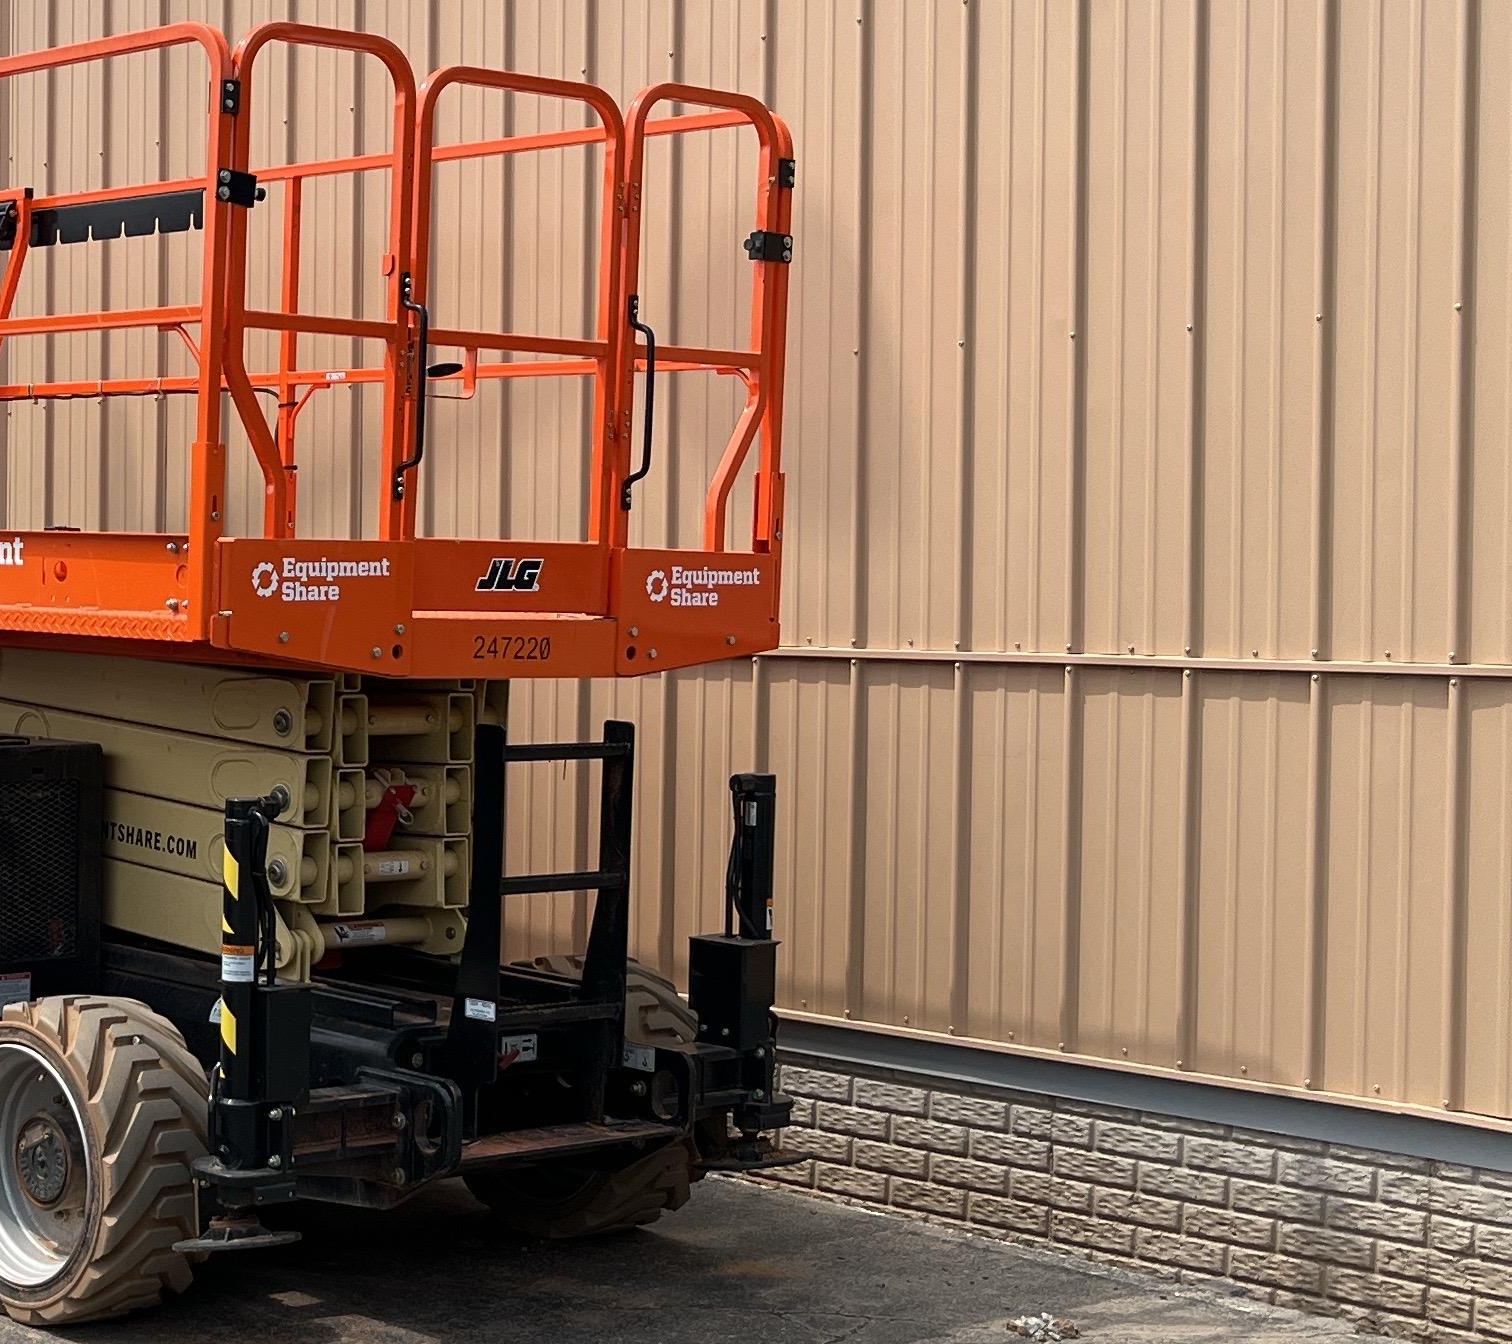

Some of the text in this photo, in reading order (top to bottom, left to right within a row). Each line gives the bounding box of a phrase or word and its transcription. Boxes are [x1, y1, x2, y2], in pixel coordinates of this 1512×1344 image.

[282, 557, 390, 581] Equipment
[475, 558, 544, 591] JLG
[671, 566, 760, 588] Equipment
[281, 581, 340, 601] Share
[670, 588, 719, 606] Share
[473, 635, 551, 660] 247220
[101, 819, 197, 859] NTSHARE.COM
